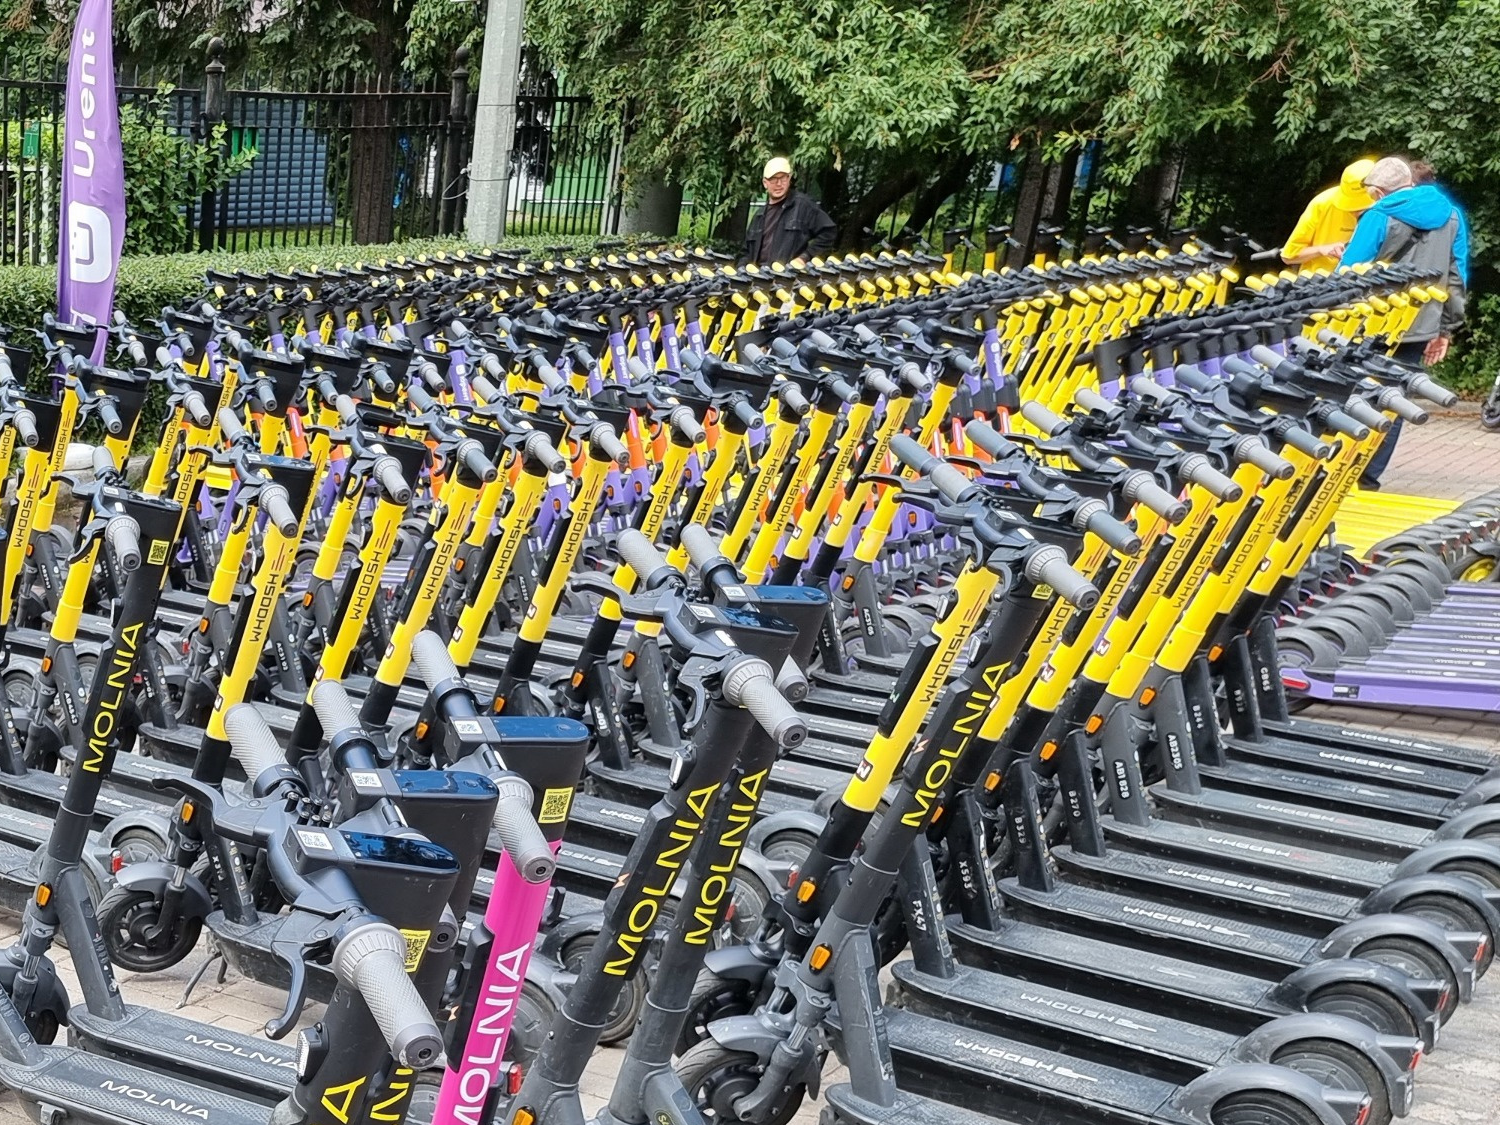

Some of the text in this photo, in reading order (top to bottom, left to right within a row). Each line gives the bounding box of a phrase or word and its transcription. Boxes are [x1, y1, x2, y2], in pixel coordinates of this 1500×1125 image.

[73, 28, 96, 178] Urent
[749, 458, 780, 512] WHOOSH
[829, 438, 857, 489] WHOOSH
[1305, 463, 1345, 521] WHOOSH
[1333, 449, 1373, 503] WHOOSH
[13, 490, 34, 548] WHOOSH
[561, 501, 592, 563] WHOOSH
[773, 478, 803, 532] WHOOSH
[422, 532, 458, 600] WHOOSH
[491, 518, 525, 580] WHOOSH
[1151, 526, 1198, 595] WHOOSH
[1173, 544, 1217, 608] WHOOSH
[1223, 523, 1264, 584] WHOOSH
[249, 573, 280, 642] WHOOSH
[349, 551, 383, 620] WHOOSH
[919, 624, 970, 703] WHOOSH
[82, 622, 144, 773] MOLNIA
[900, 661, 1012, 828] MOLNIA
[683, 768, 768, 946] MOLNIA
[1208, 836, 1291, 858] WHOOSH
[602, 782, 721, 976] MOLNIA
[1168, 868, 1253, 890] WHOOSH
[1123, 905, 1211, 931] WHOOSH
[1020, 992, 1117, 1023] WHOOSH
[185, 1034, 300, 1070] MOLNIA
[954, 1038, 1056, 1073] WHOOSH
[99, 1079, 210, 1120] MOLNIA
